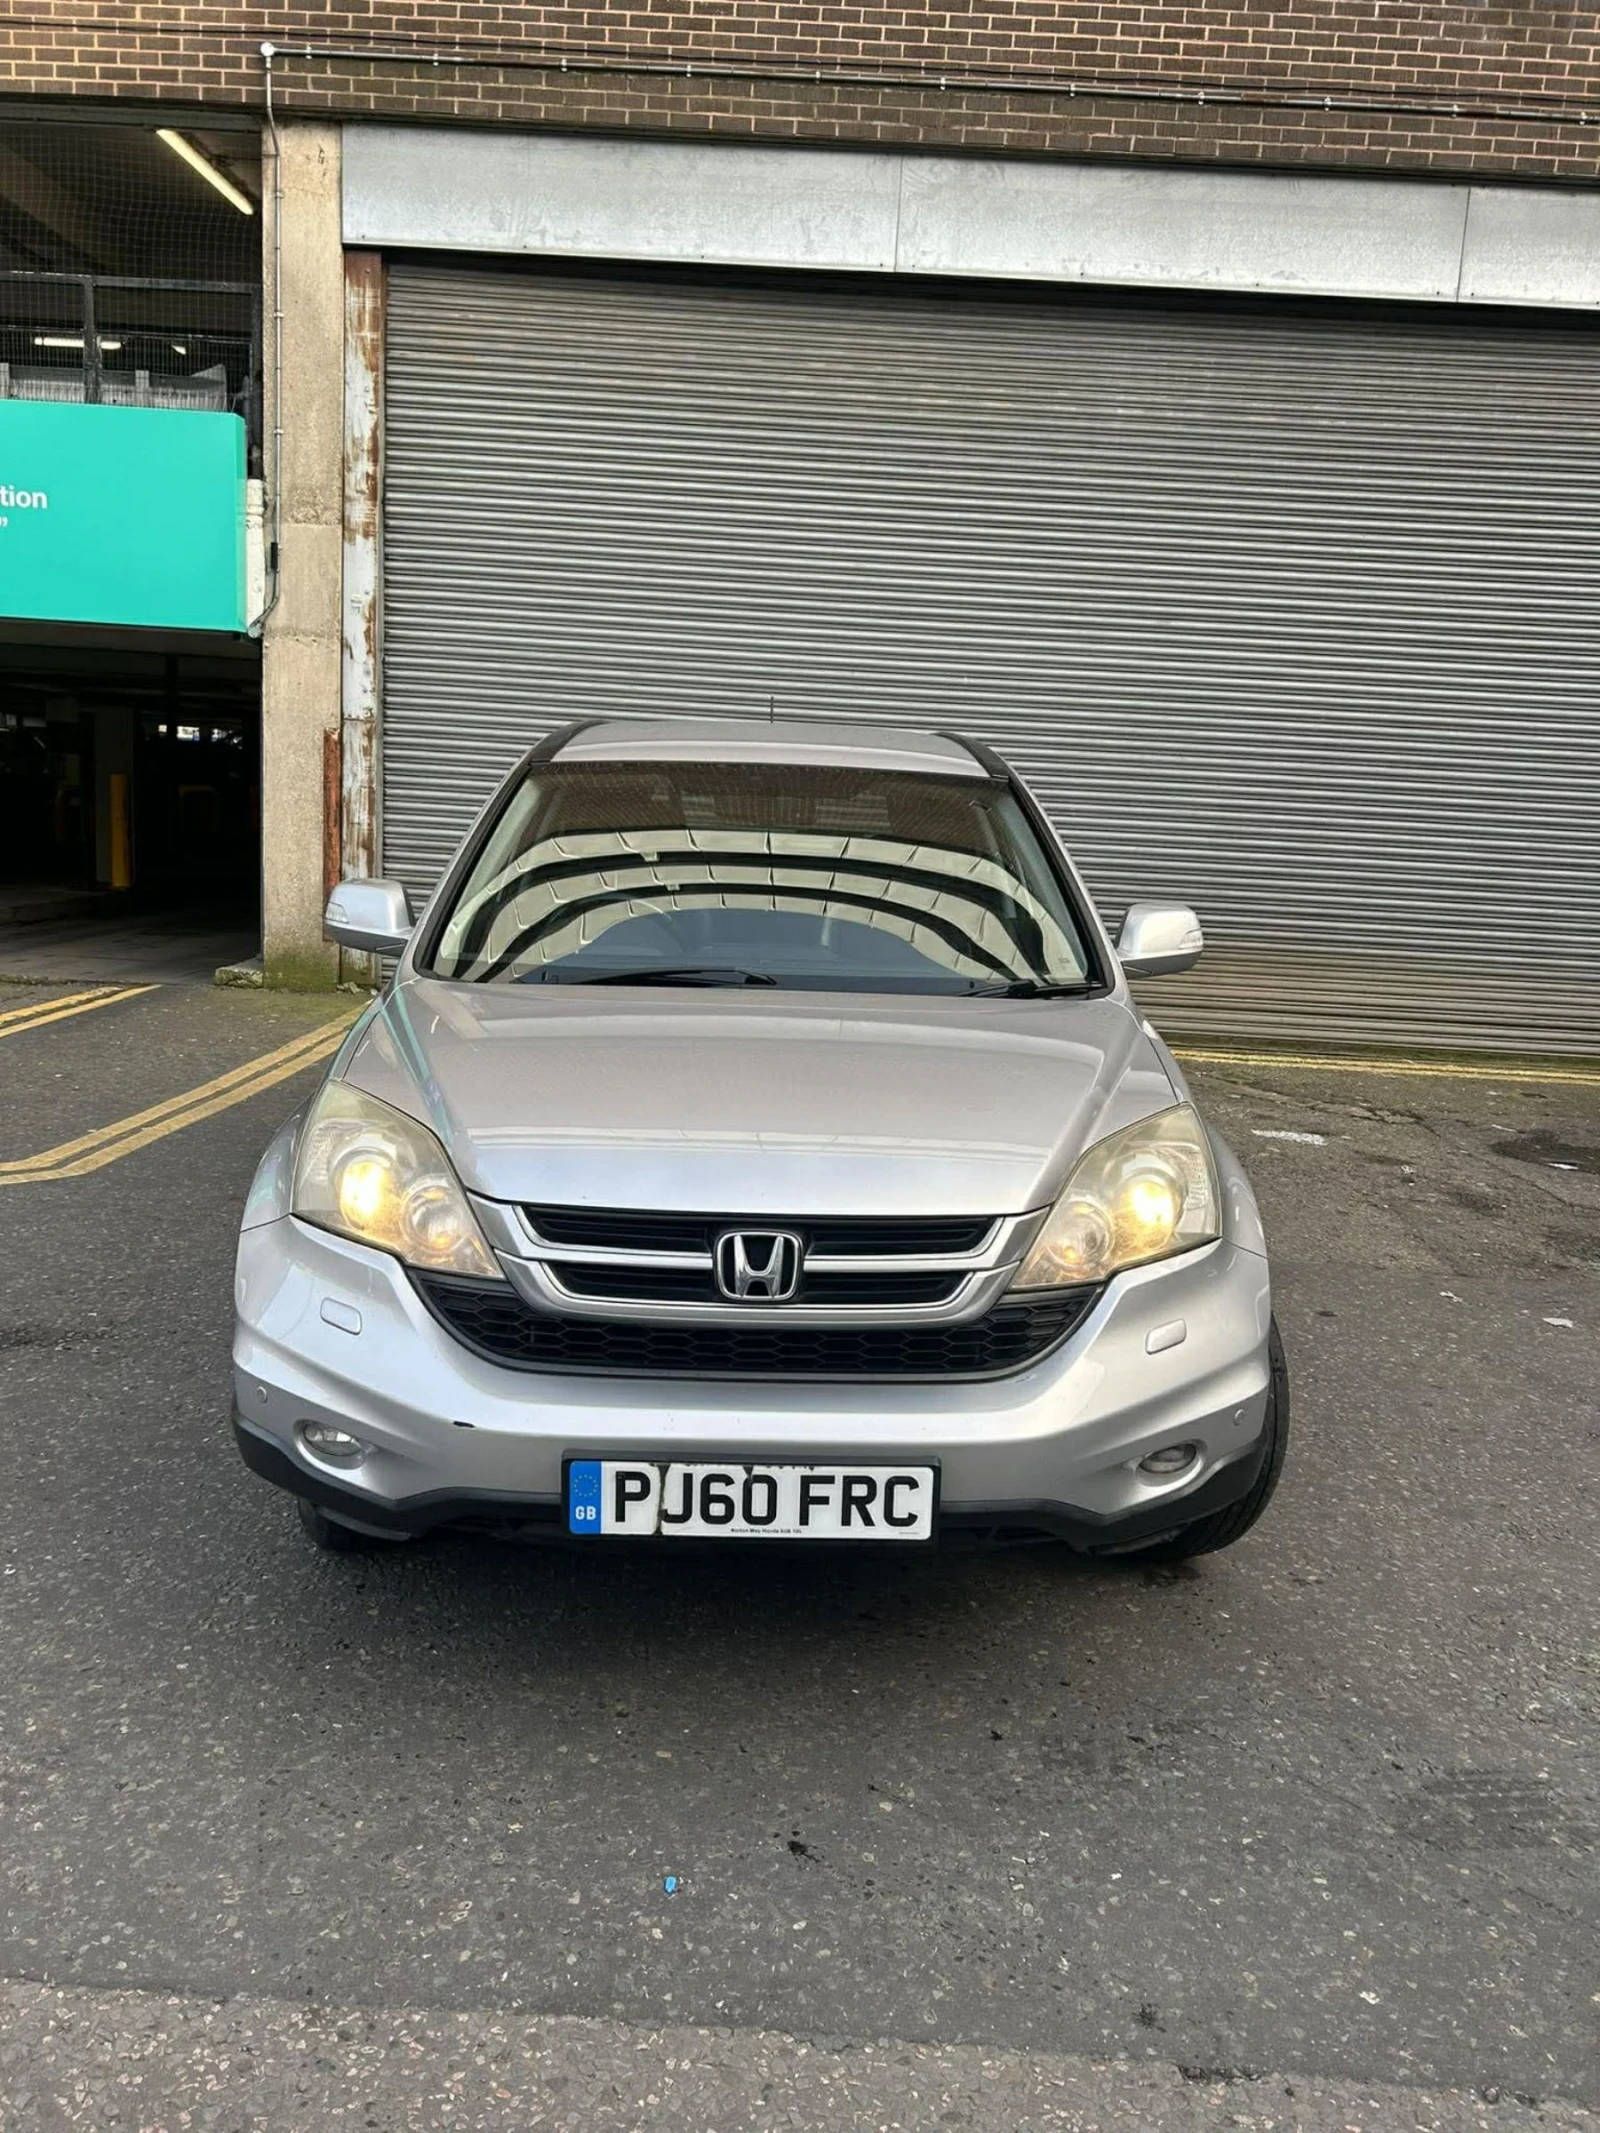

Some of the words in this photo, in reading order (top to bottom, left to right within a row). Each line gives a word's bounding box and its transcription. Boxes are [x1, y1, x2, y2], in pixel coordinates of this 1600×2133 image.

[0, 485, 48, 509] tion
[614, 1471, 777, 1525] PJ60
[799, 1475, 920, 1527] FRC
[575, 1505, 596, 1520] GB
